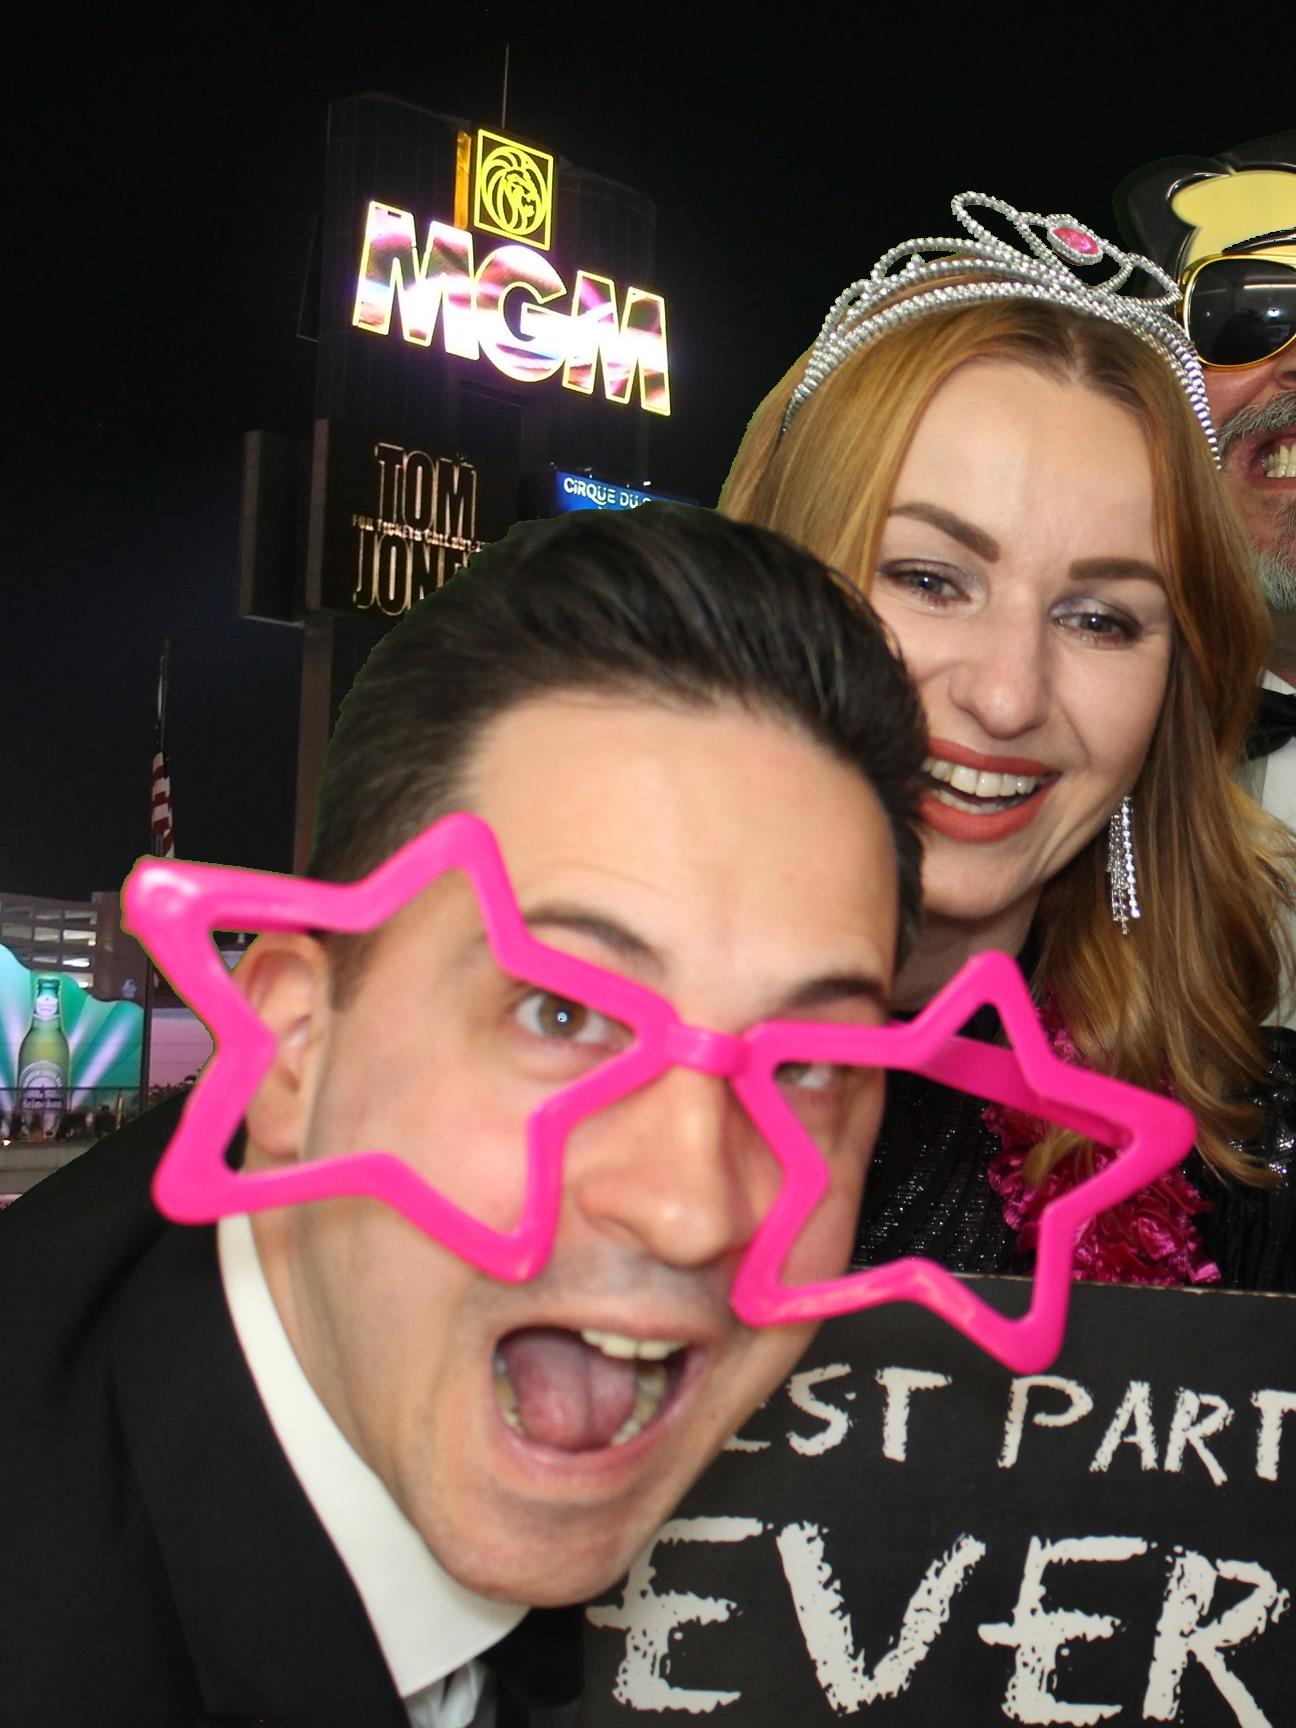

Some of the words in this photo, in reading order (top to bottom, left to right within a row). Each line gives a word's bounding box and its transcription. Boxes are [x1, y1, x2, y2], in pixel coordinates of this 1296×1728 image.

[352, 200, 671, 416] MGM
[374, 442, 477, 540] TOM
[352, 527, 470, 616] JON
